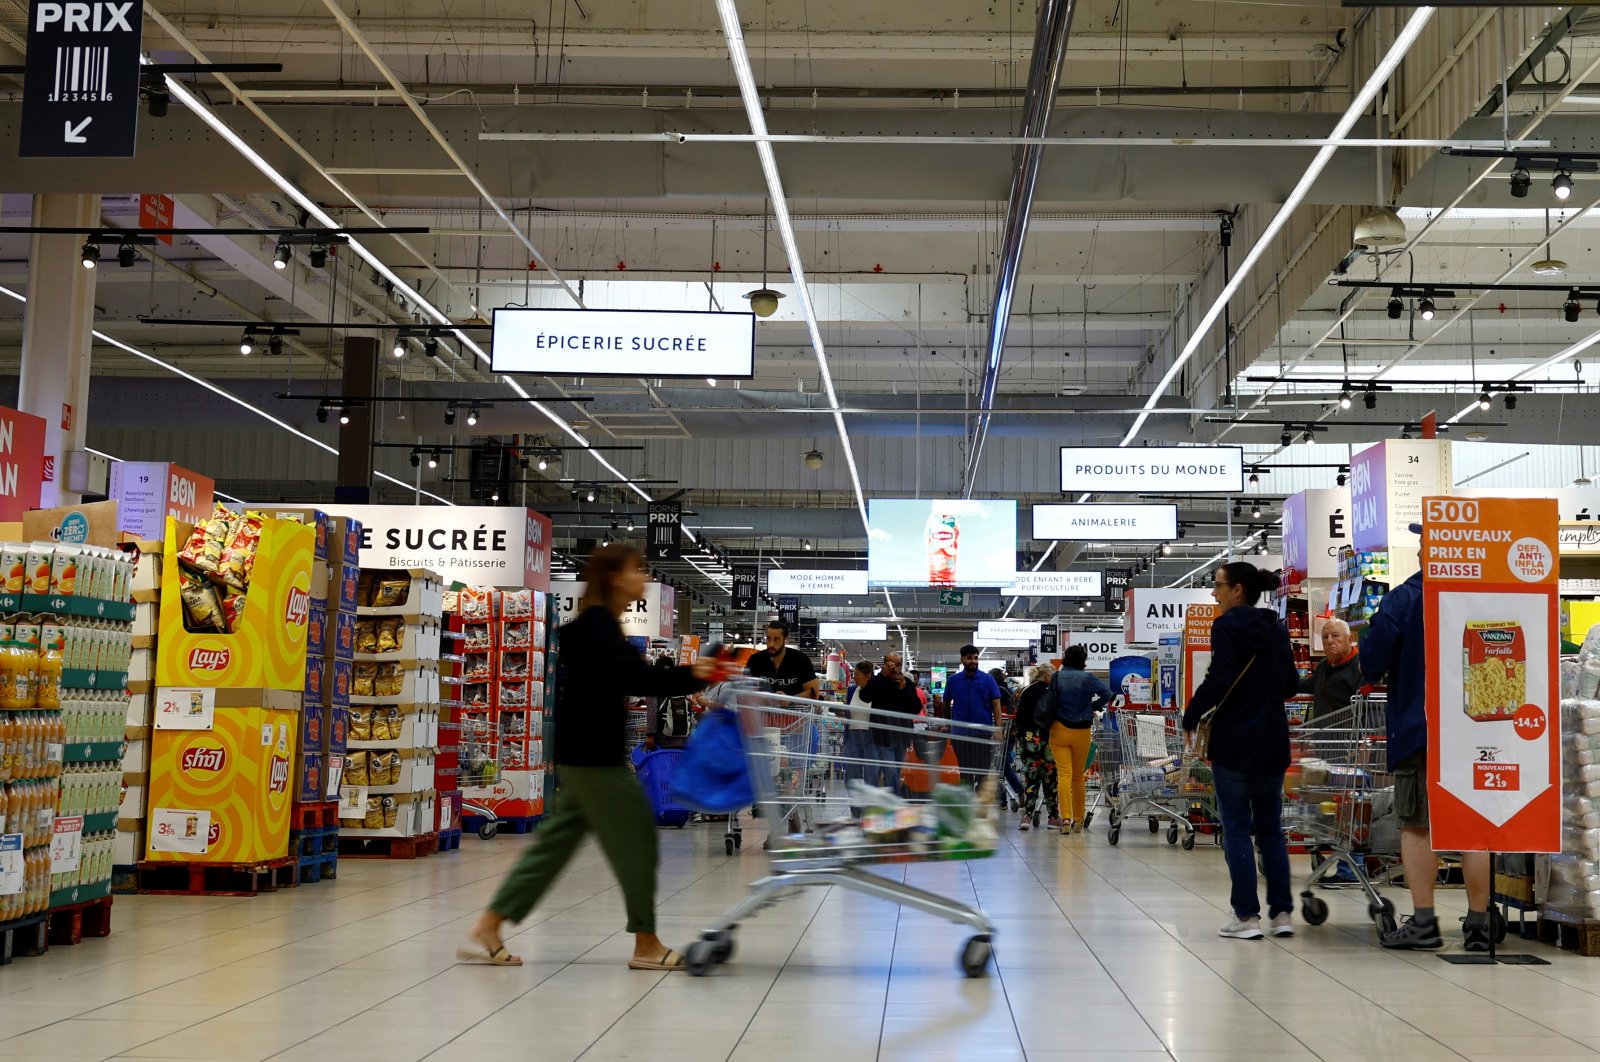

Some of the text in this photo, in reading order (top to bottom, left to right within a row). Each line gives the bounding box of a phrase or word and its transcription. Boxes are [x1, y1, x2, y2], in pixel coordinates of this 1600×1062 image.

[36, 2, 133, 32] PRIX
[536, 332, 706, 351] ÉPICERIE SUCRÉE
[1408, 456, 1420, 464] 34
[1076, 465, 1226, 475] PRODUITS DU MONDE
[139, 476, 149, 484] 19
[1351, 460, 1372, 498] BON
[170, 474, 196, 510] BON
[650, 504, 679, 512] BORNE
[1428, 502, 1478, 522] 500
[650, 513, 679, 523] PRIX
[1352, 496, 1378, 534] PLAN
[1071, 518, 1137, 527] ANIMALERIE
[527, 516, 542, 545] BON
[1429, 529, 1512, 542] NOUVEAUX
[386, 524, 507, 551] SUCRÉE
[1429, 546, 1486, 560] PRIX EN
[1517, 544, 1538, 552] DEFI
[390, 556, 506, 568] Biscuits & Pâtisserie
[526, 546, 544, 574] PLAN
[1518, 552, 1546, 560] ANTI-
[1430, 564, 1480, 576] BAISSE
[1515, 560, 1544, 568] INFLA
[734, 574, 756, 582] PRIX
[1520, 568, 1545, 576] TION
[1106, 578, 1128, 586] PRIX
[287, 587, 310, 627] Lay's
[1188, 606, 1213, 617] 500
[633, 616, 648, 624] Thé
[1146, 622, 1170, 630] Chats,
[1484, 646, 1512, 655] Farfalle
[190, 647, 230, 670] Lay's
[184, 747, 223, 771] Lay's
[270, 754, 289, 794] Lay's
